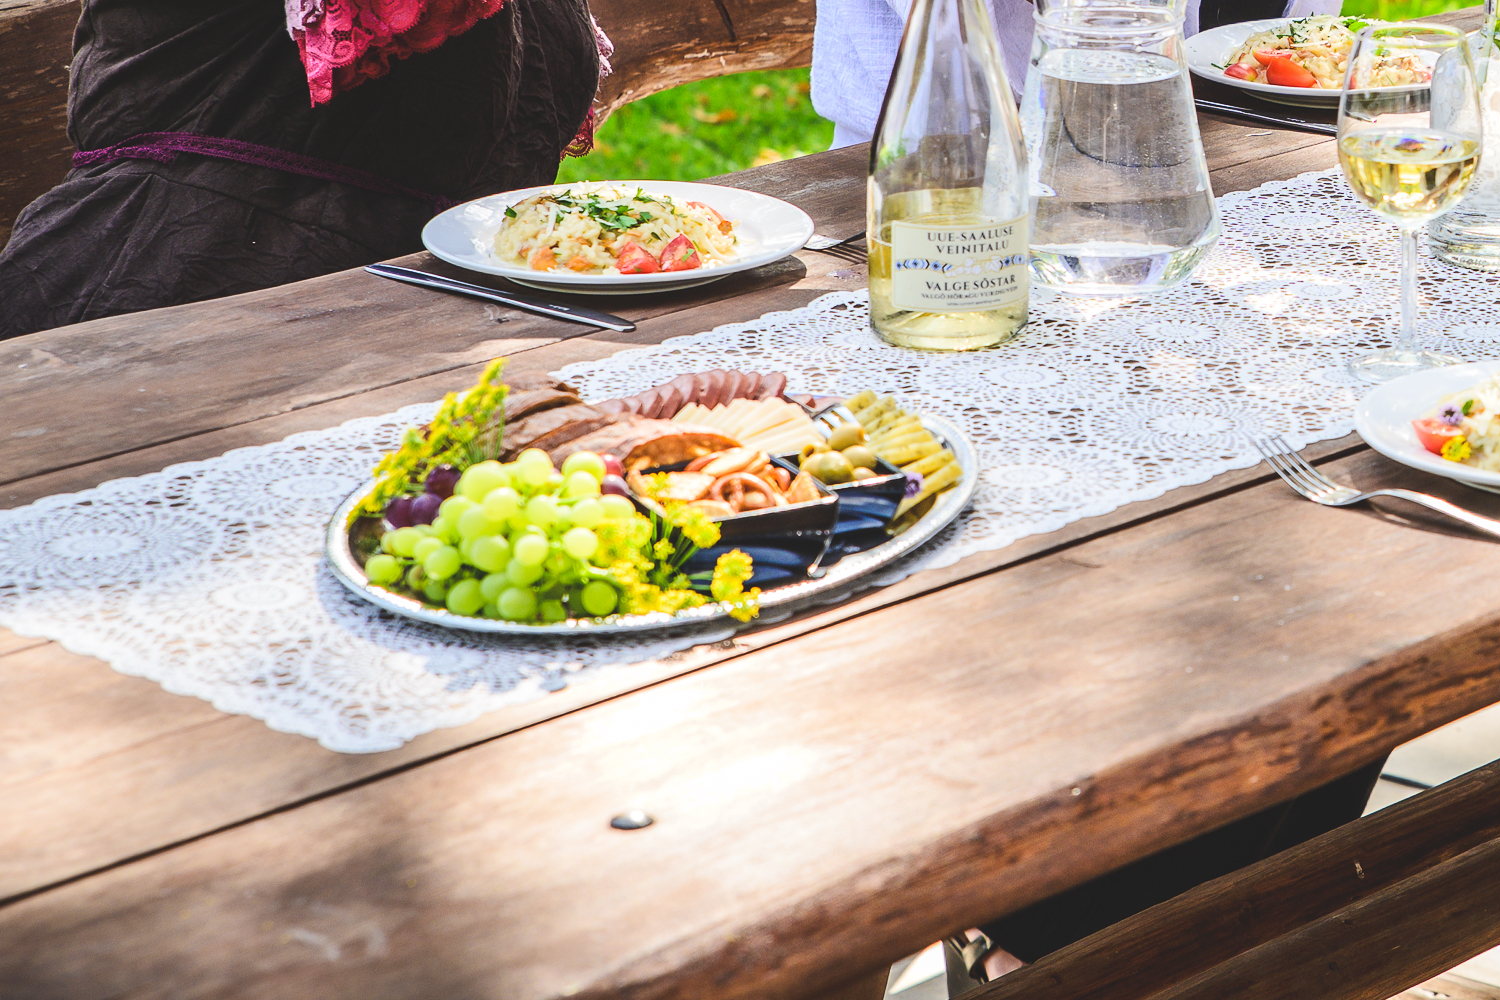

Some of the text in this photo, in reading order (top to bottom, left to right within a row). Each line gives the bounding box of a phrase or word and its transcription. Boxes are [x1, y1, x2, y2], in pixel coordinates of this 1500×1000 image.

[928, 226, 1014, 242] UUE-SAALUSE
[936, 240, 1009, 254] VEINITALU
[926, 274, 1016, 291] VALGE SÕSTAR
